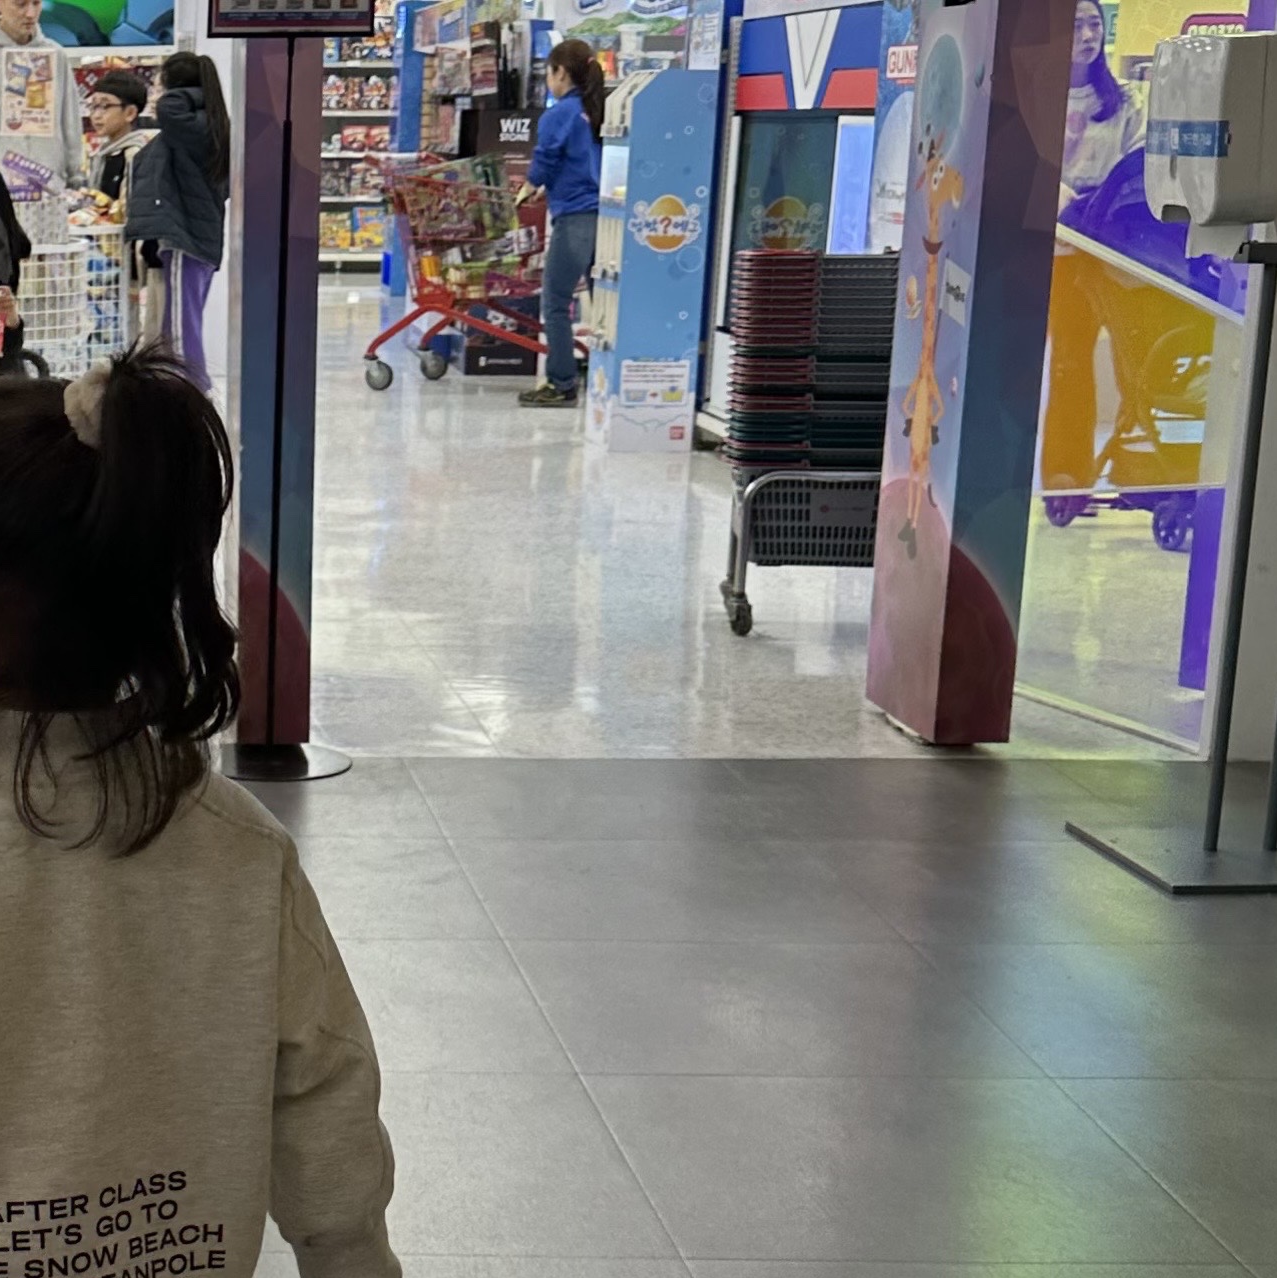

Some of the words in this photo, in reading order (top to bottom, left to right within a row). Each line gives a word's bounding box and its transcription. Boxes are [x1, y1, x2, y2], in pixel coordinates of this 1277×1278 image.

[500, 118, 531, 132] WIZ
[99, 1170, 188, 1210] CLASS
[95, 1210, 132, 1238] GO
[141, 1199, 179, 1224] TO
[129, 1223, 224, 1260] BEACH
